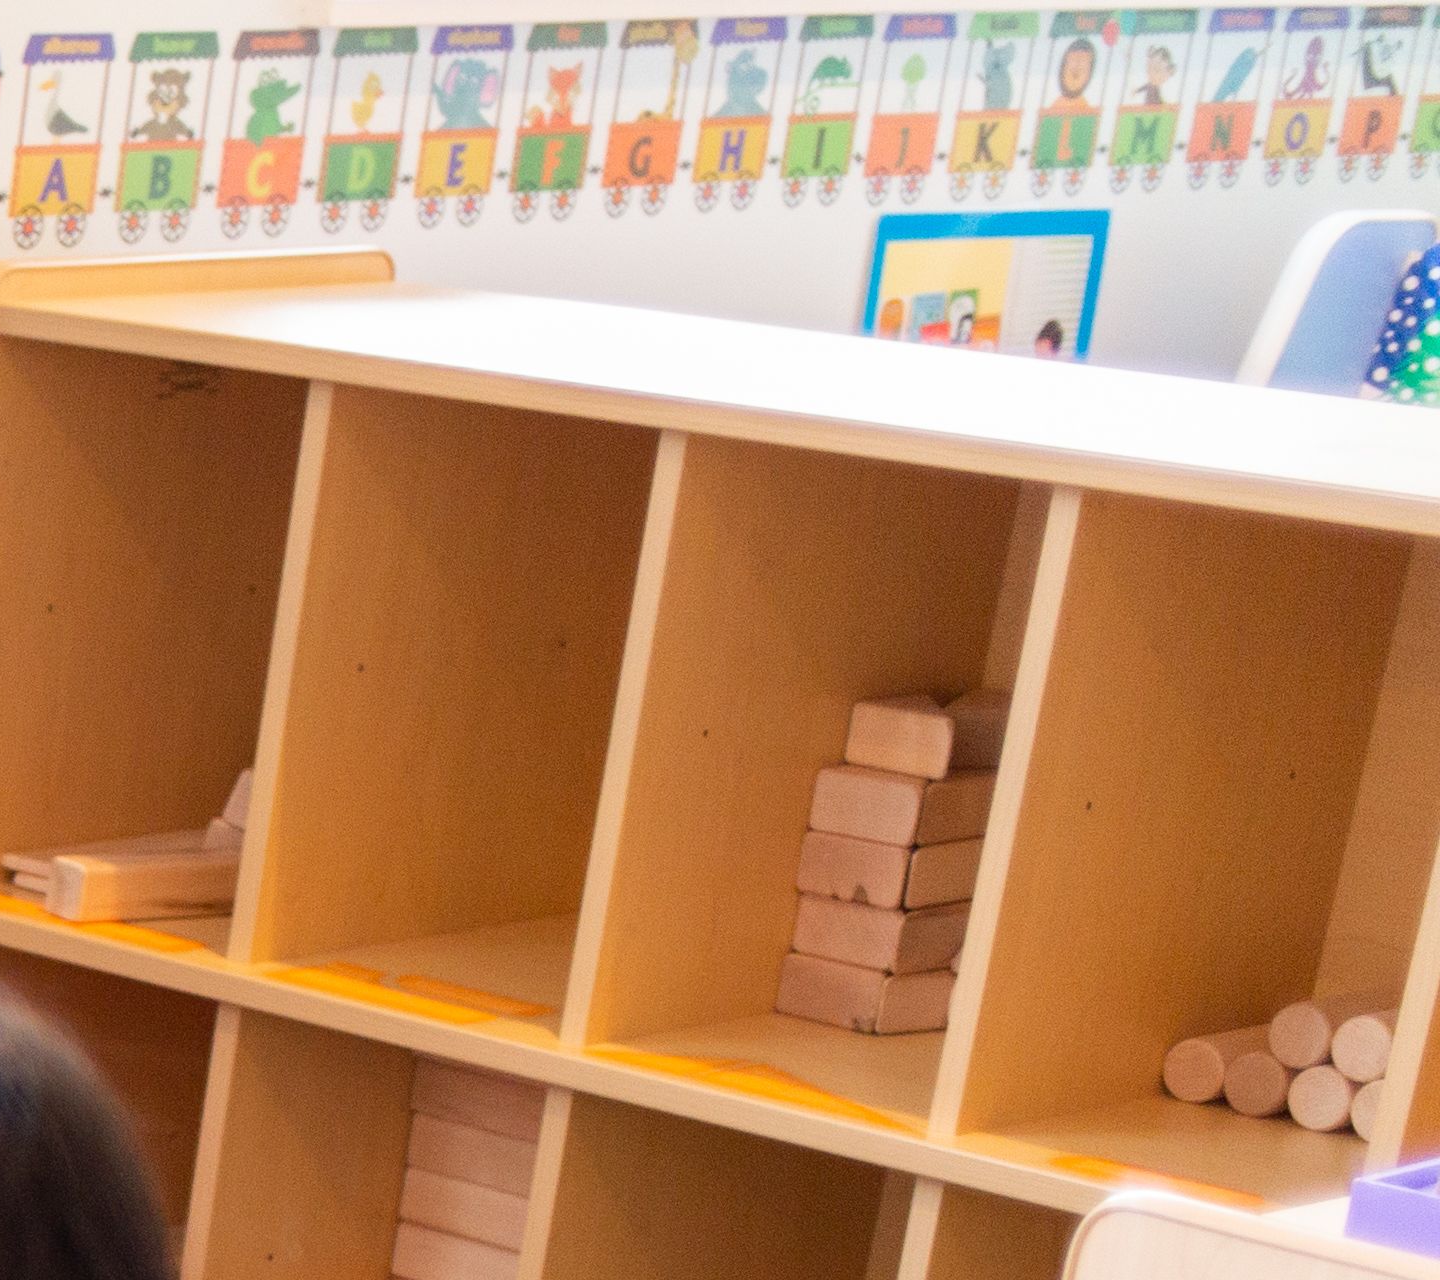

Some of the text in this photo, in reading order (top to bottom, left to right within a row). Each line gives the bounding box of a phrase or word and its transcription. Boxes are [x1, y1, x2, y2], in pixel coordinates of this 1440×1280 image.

[38, 158, 68, 203] A
[148, 155, 172, 200] B
[246, 151, 274, 198] C
[346, 146, 377, 192] D
[445, 143, 466, 187] E
[541, 139, 565, 185] F
[629, 136, 652, 178] G
[718, 129, 747, 173] H
[974, 121, 999, 164] K
[1056, 118, 1073, 162] L
[1130, 116, 1161, 158] M
[1211, 113, 1235, 152] N
[1284, 112, 1309, 150] O
[1364, 110, 1382, 150] P
